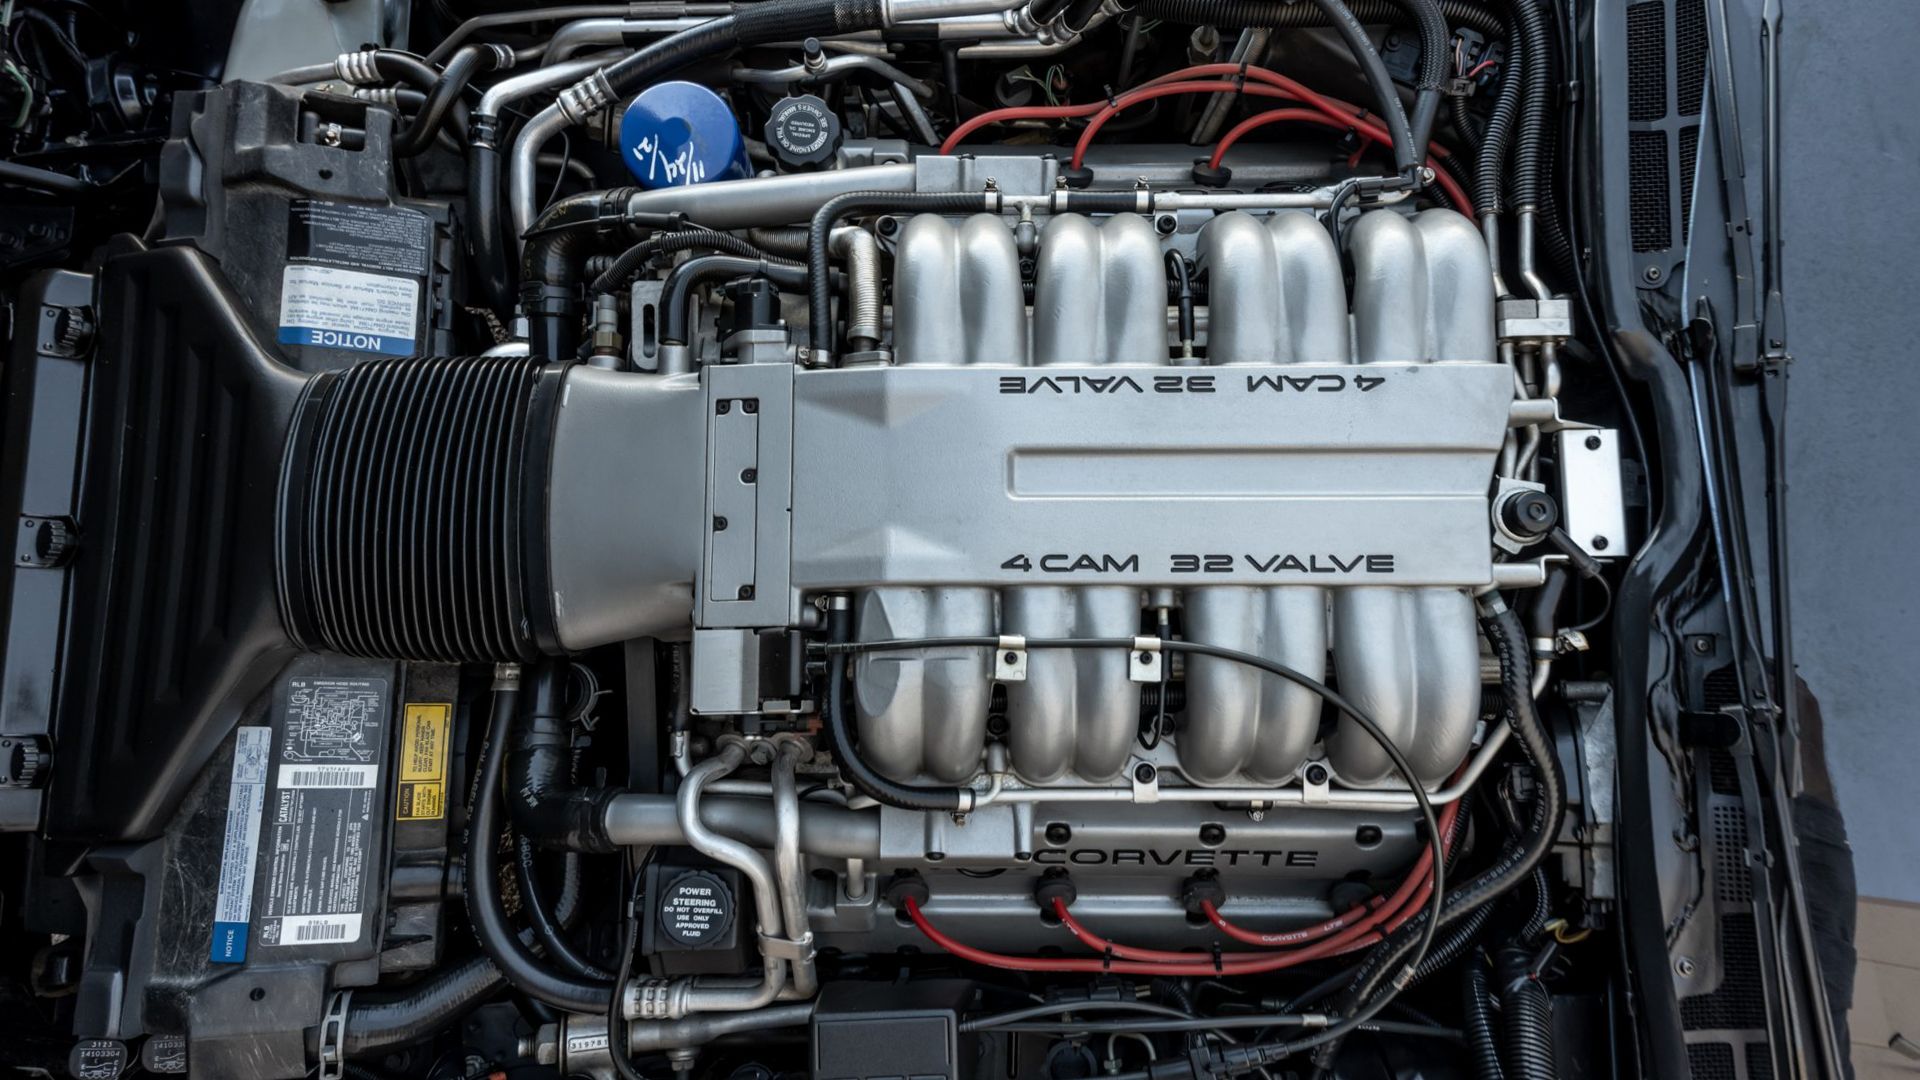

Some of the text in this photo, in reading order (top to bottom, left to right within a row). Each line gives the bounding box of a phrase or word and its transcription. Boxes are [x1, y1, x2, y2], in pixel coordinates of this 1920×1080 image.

[311, 330, 381, 349] NOTICE
[999, 374, 1386, 394] 4 CAM 32 VALVE
[1000, 554, 1394, 572] 4 CAM 32 VALVE
[278, 791, 290, 822] CATALYST
[401, 788, 410, 814] CAUTION
[1033, 849, 1318, 867] CORVETTE
[680, 888, 712, 896] POWER
[672, 898, 716, 906] STEERING
[225, 929, 234, 956] NOTICE
